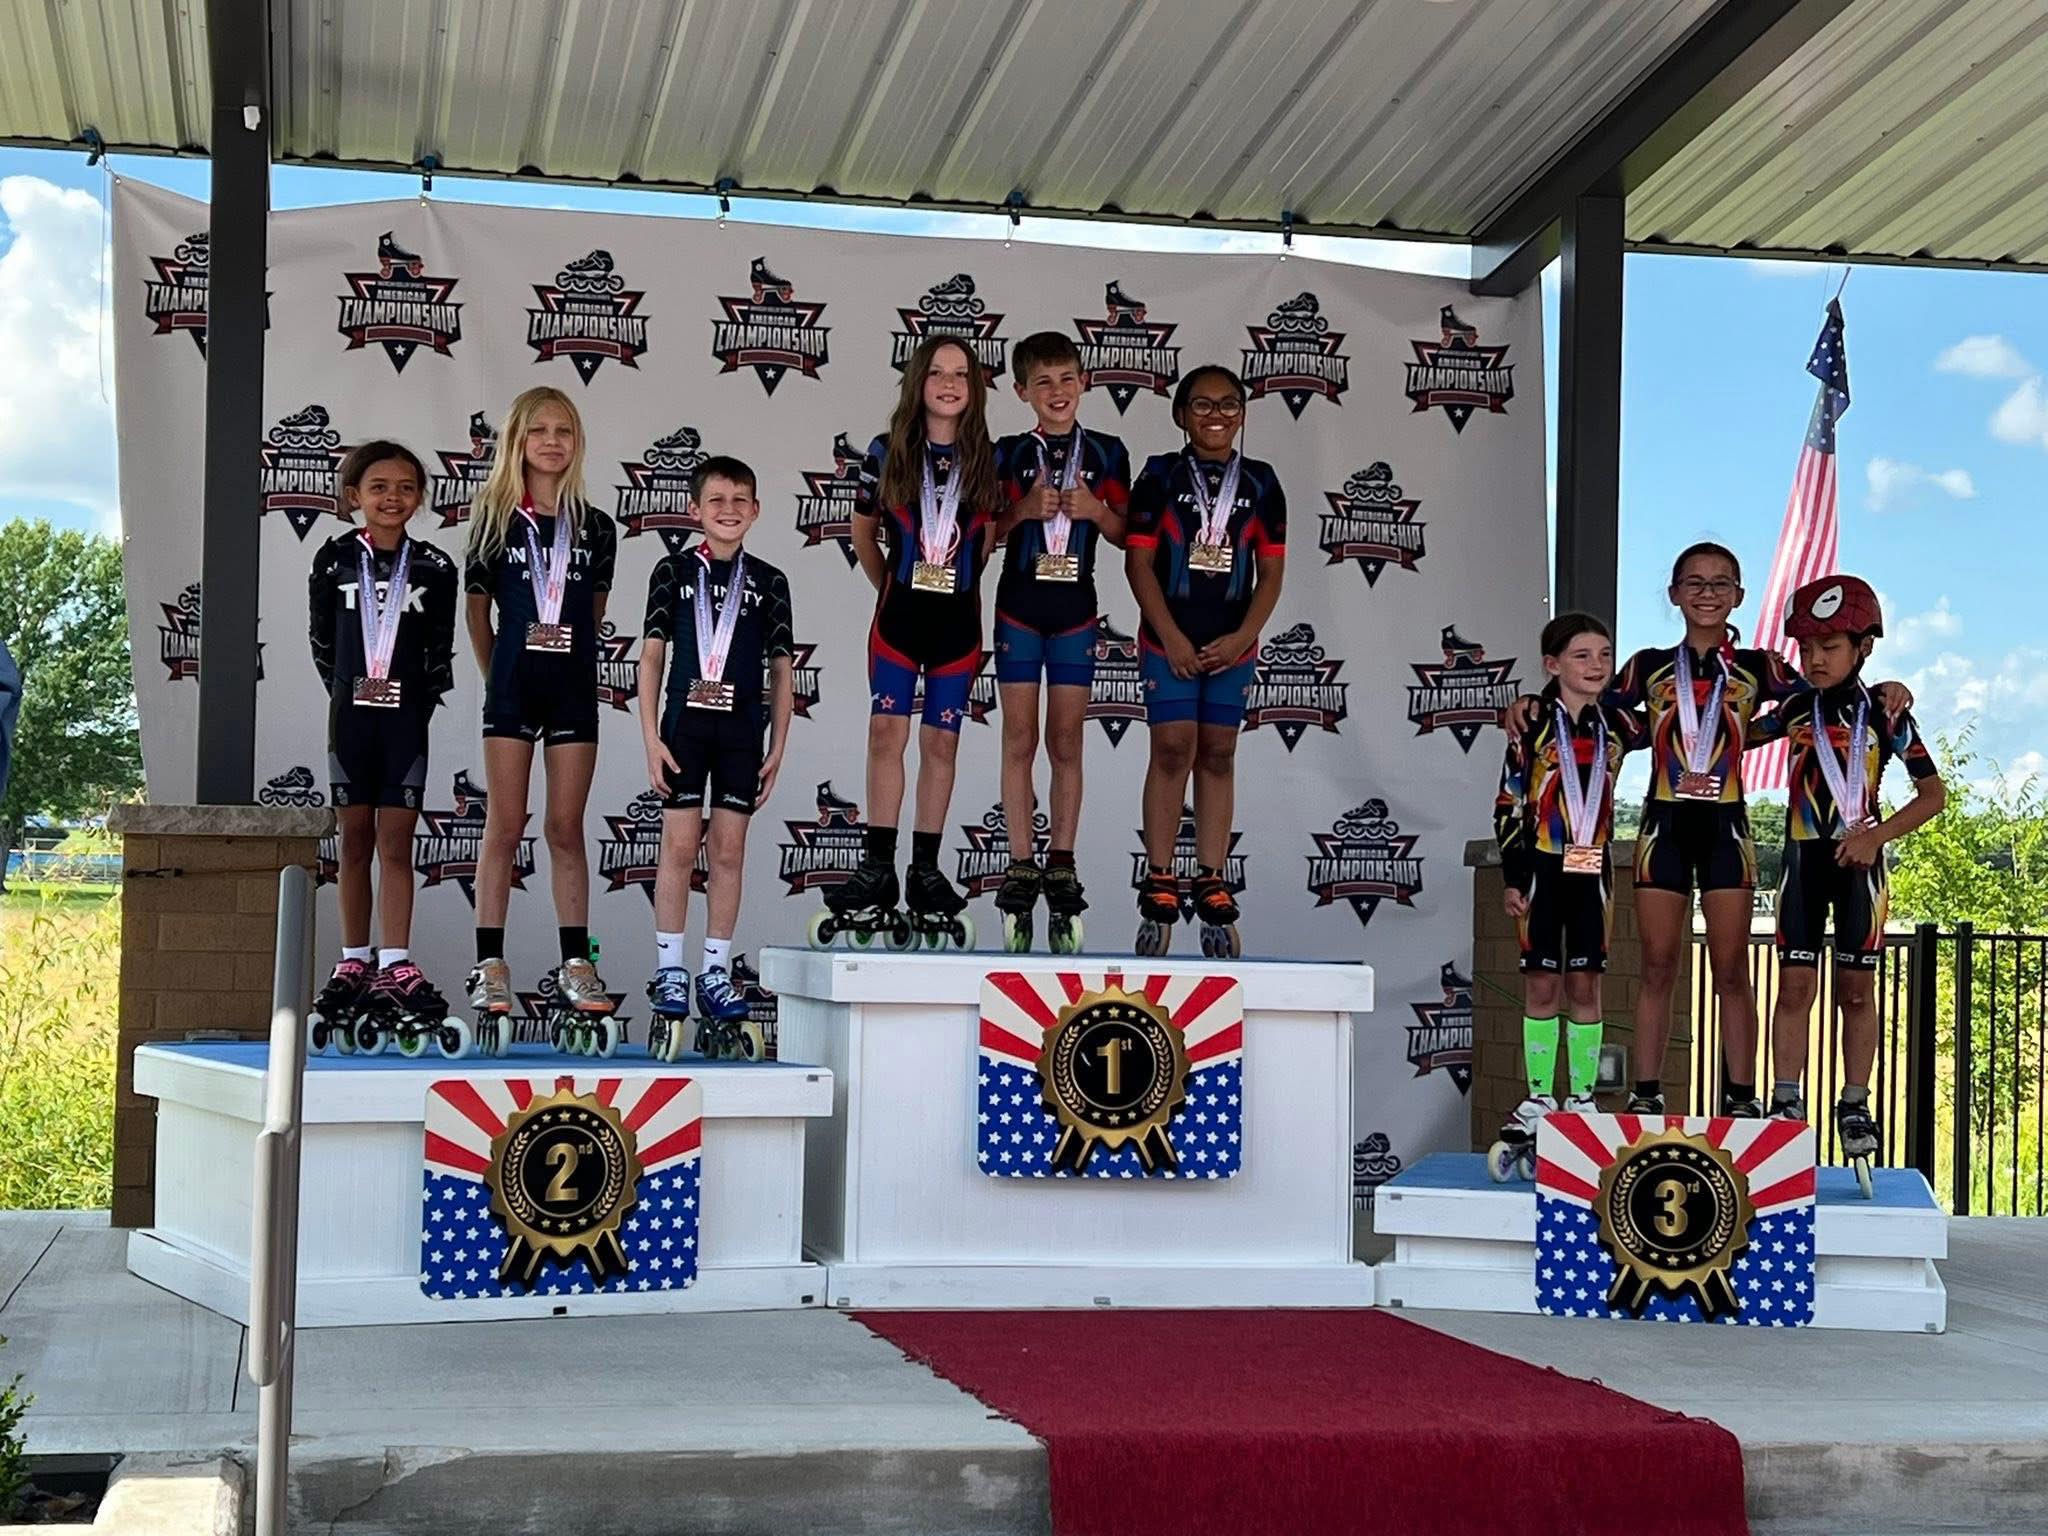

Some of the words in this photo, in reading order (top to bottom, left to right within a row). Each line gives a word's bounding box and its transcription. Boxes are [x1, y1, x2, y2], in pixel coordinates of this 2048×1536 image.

[377, 289, 426, 302] AMERICAN
[565, 303, 613, 315] AMERICAN
[342, 299, 457, 333] CHAMPIONSHIP
[749, 314, 796, 326] AMERICAN
[531, 313, 644, 346] CHAMPIONSHIP
[715, 325, 825, 357] CHAMPIONSHIP
[1102, 335, 1147, 346] AMERICAN
[1276, 342, 1320, 353] AMERICAN
[1243, 353, 1345, 384] CHAMPIONSHIP
[1437, 358, 1481, 368] AMERICAN
[1408, 367, 1511, 397] CHAMPIONSHIP
[278, 458, 329, 470] AMERICAN
[1351, 509, 1394, 520] AMERICAN
[1324, 517, 1421, 550] CHAMPIONSHIP
[1094, 670, 1140, 680] AMERICAN
[1269, 675, 1315, 684] AMERICAN
[1442, 676, 1488, 686] AMERICAN
[1246, 685, 1344, 712] HAMPIONSHIP
[816, 837, 862, 847] AMERICAN
[1342, 849, 1389, 858] AMERICAN
[1311, 858, 1419, 886] CHAMPIONSHIP
[1096, 1037, 1133, 1095] 1st
[545, 1142, 594, 1202] 2nd
[1653, 1179, 1701, 1237] 3rd
